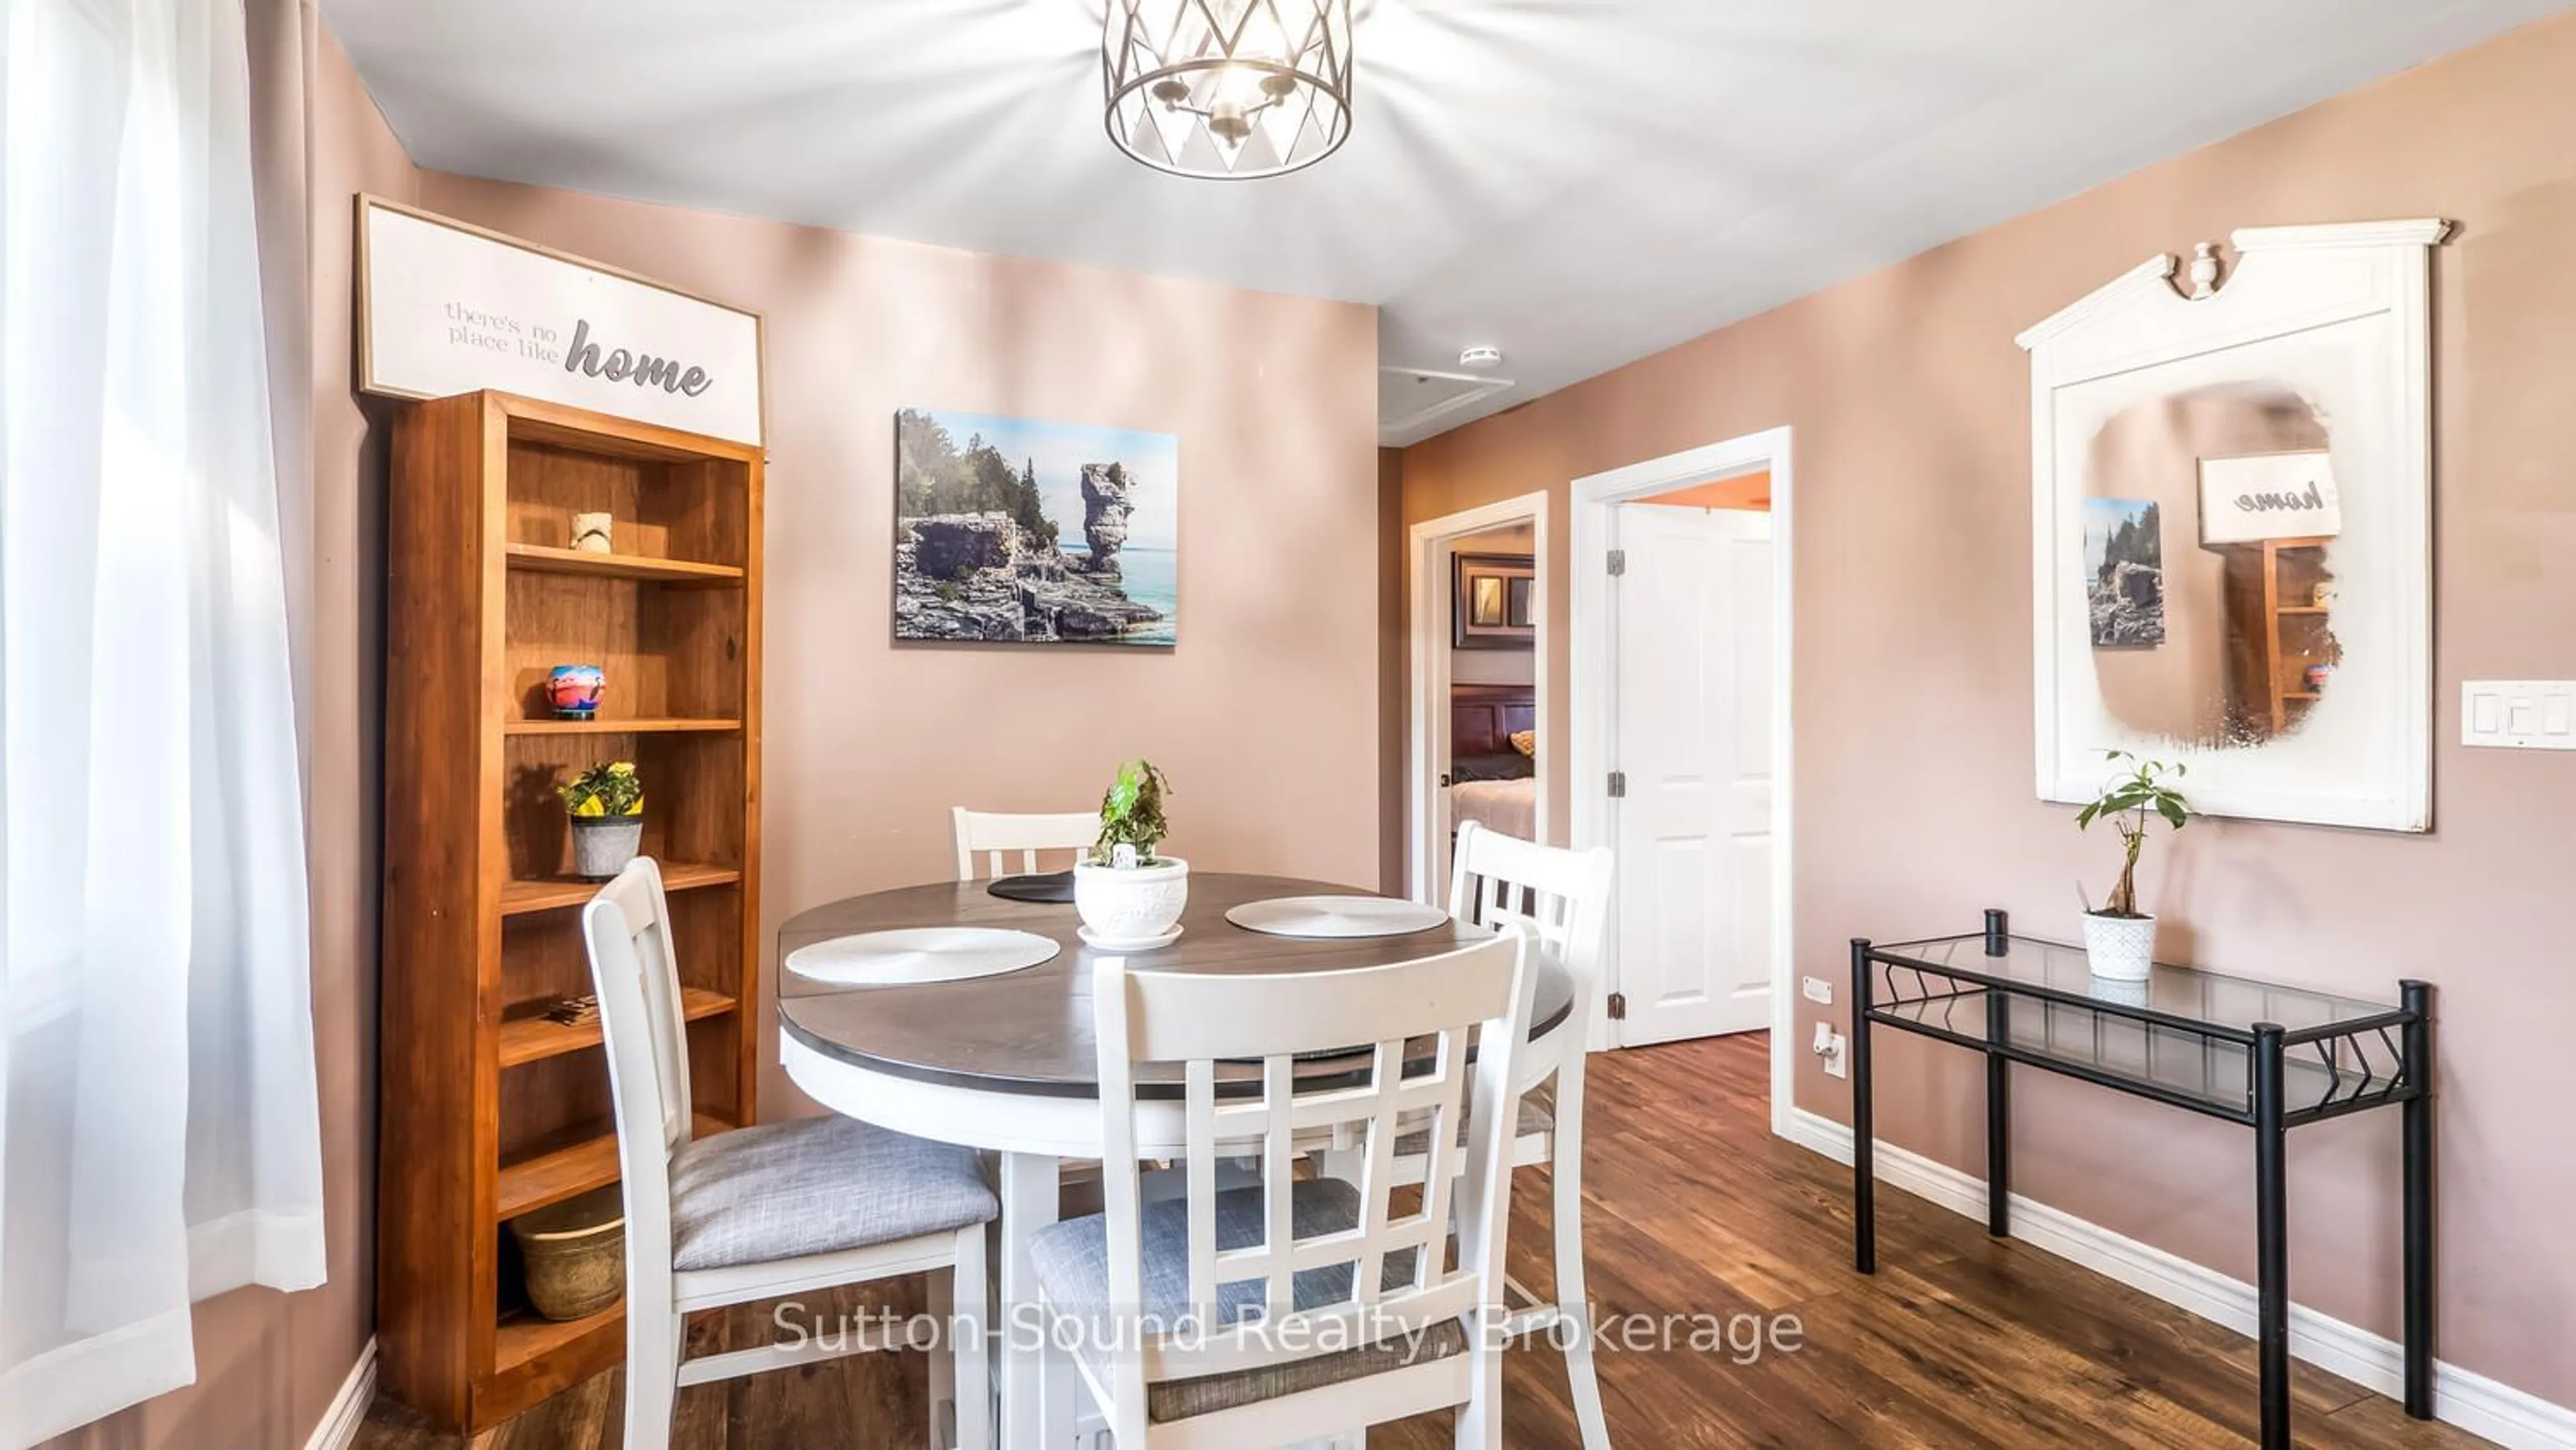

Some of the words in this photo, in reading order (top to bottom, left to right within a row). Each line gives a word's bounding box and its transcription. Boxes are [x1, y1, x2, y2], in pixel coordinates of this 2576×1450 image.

[444, 302, 521, 333] there's
[533, 326, 557, 343] no
[449, 325, 508, 353] place
[519, 338, 559, 364] like
[565, 319, 712, 397] home
